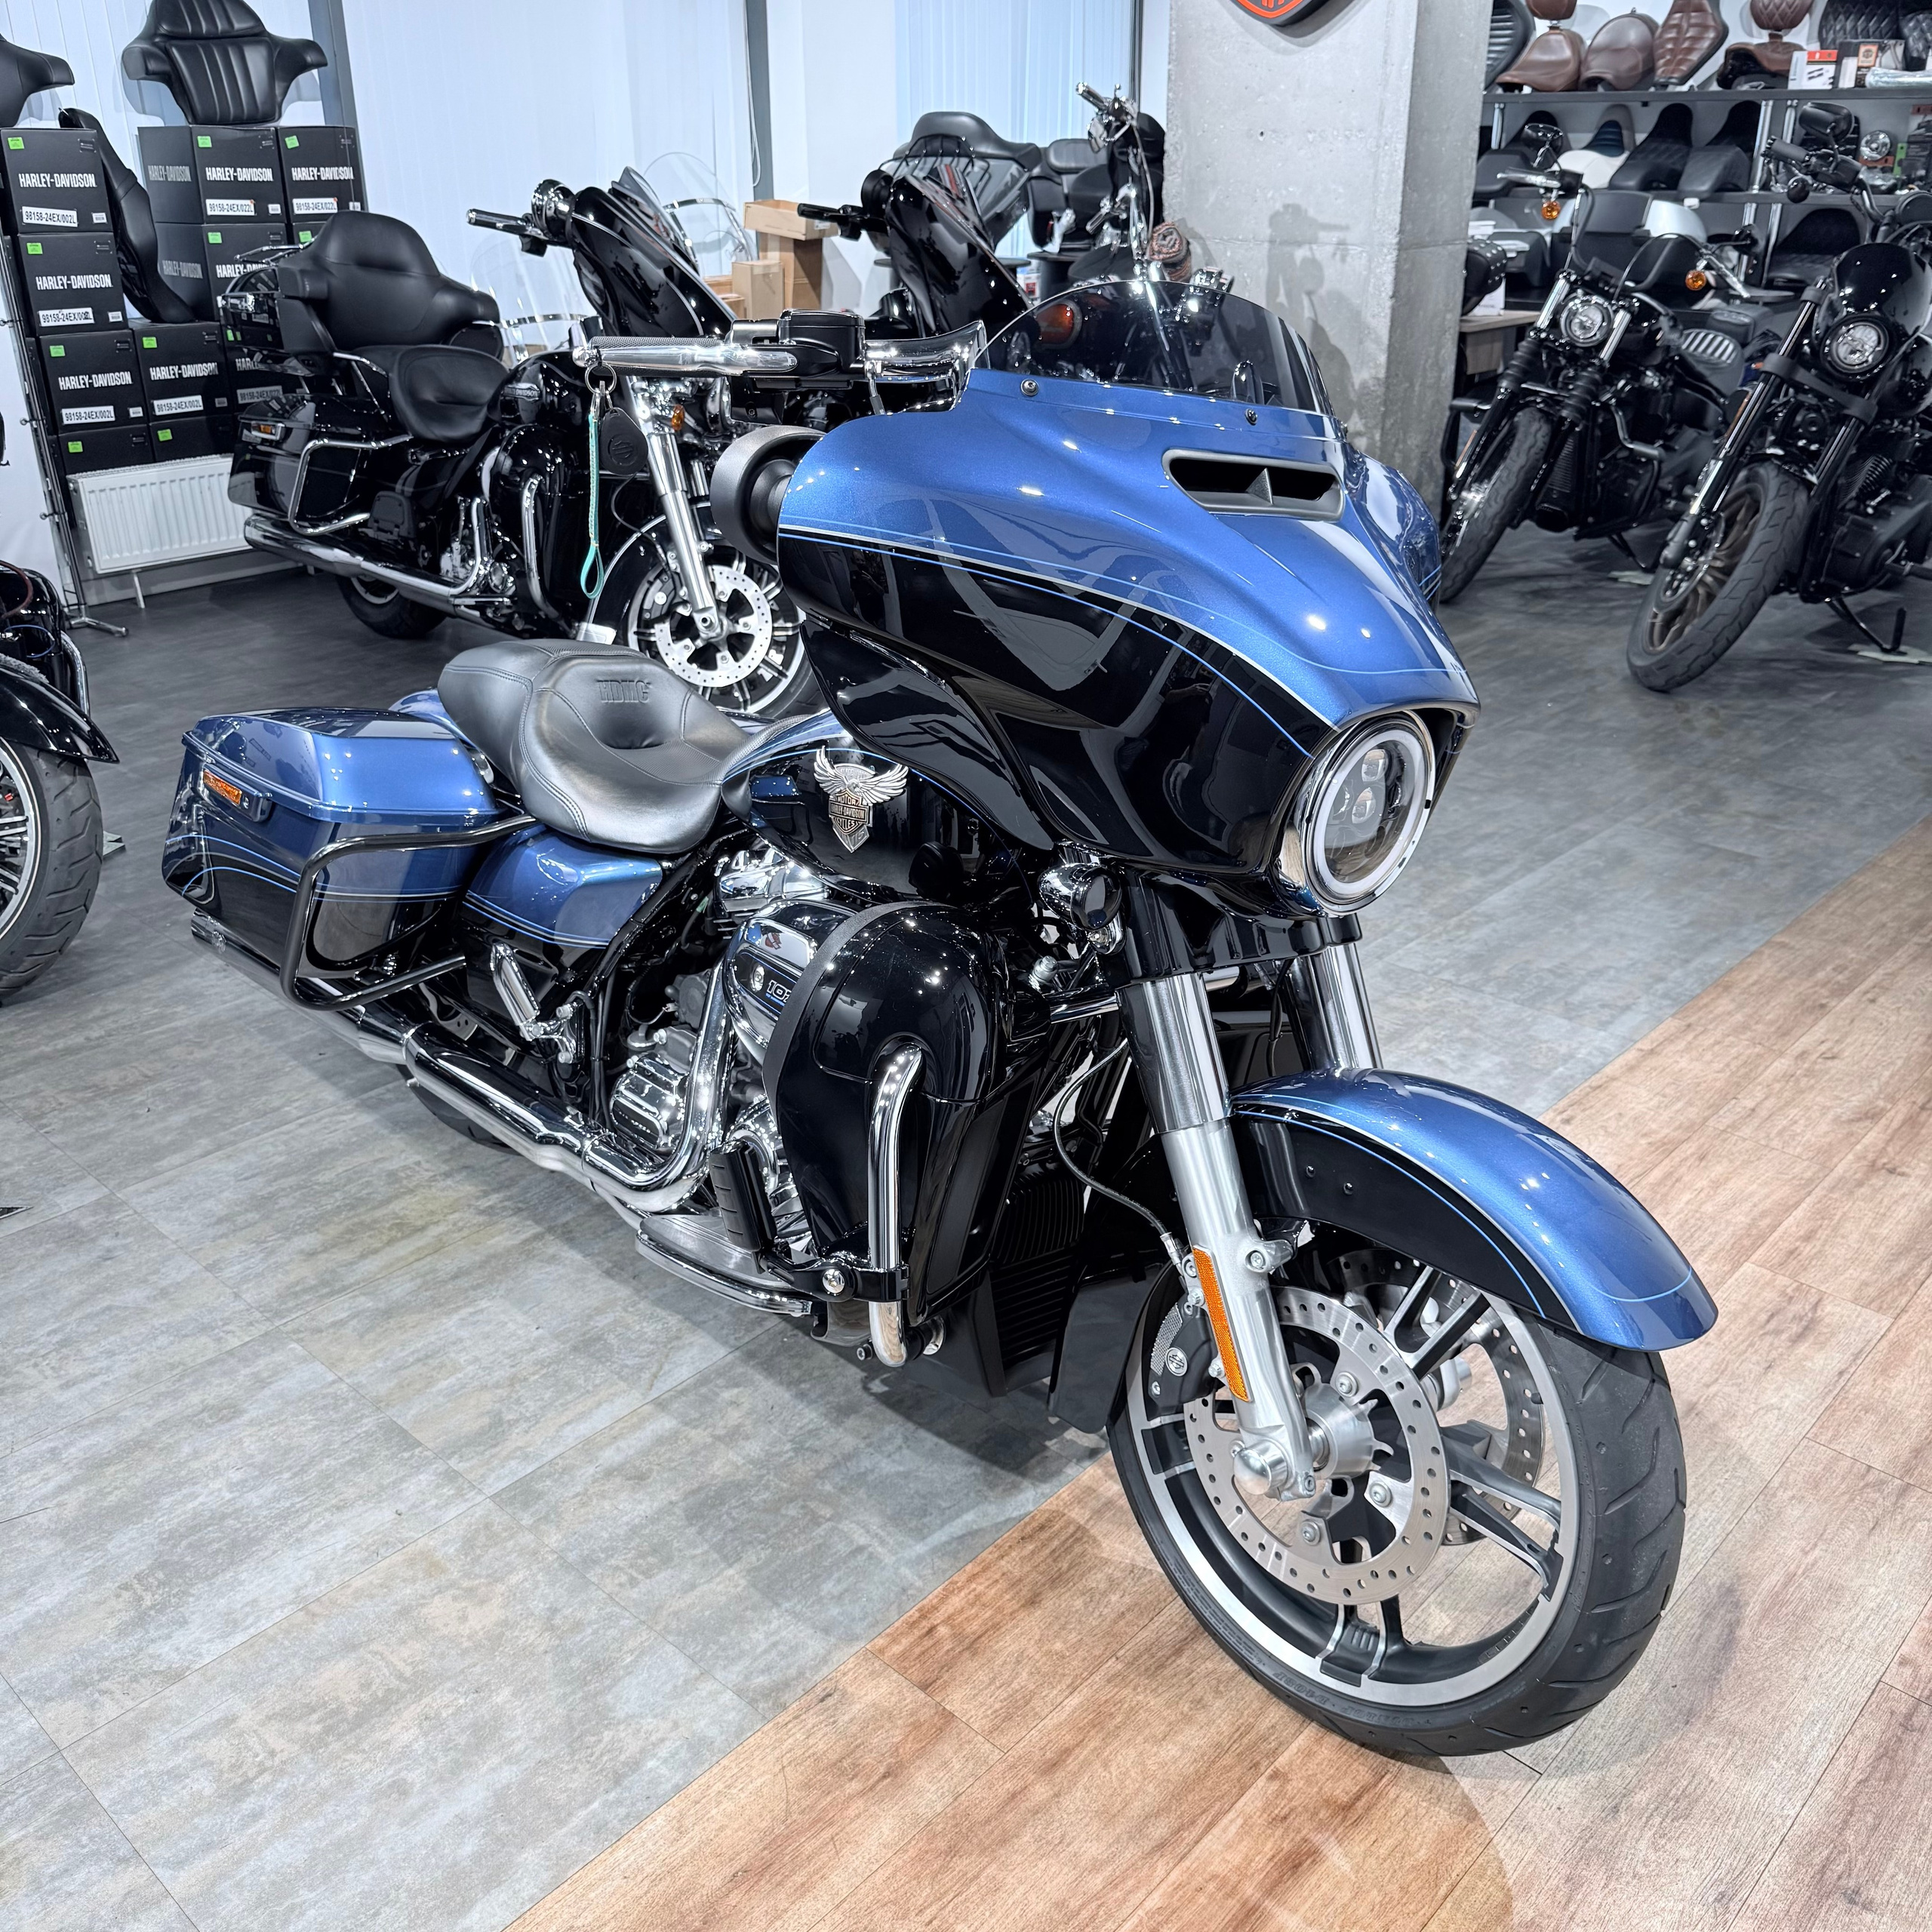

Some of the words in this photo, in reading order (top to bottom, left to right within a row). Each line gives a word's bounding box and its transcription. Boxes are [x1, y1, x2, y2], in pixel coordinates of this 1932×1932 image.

[18, 173, 97, 188] HARLEY-DAVIDSON
[205, 167, 273, 182] HARLEY-DAVIDSON
[291, 166, 355, 181] HARLEY-DAVIDSON
[25, 211, 77, 224] 98158-24EX/002L
[35, 274, 112, 291] HARLEY-DAVIDSON
[149, 362, 219, 381] HARLEY-DAVIDSON
[58, 371, 133, 391] HARLEY-DAVIDSON
[65, 410, 114, 422] 98158-24EX/002L
[837, 794, 857, 805] MOTOR
[831, 803, 865, 820] HARLEY-DAVIDSON
[836, 817, 855, 830] CYCLES
